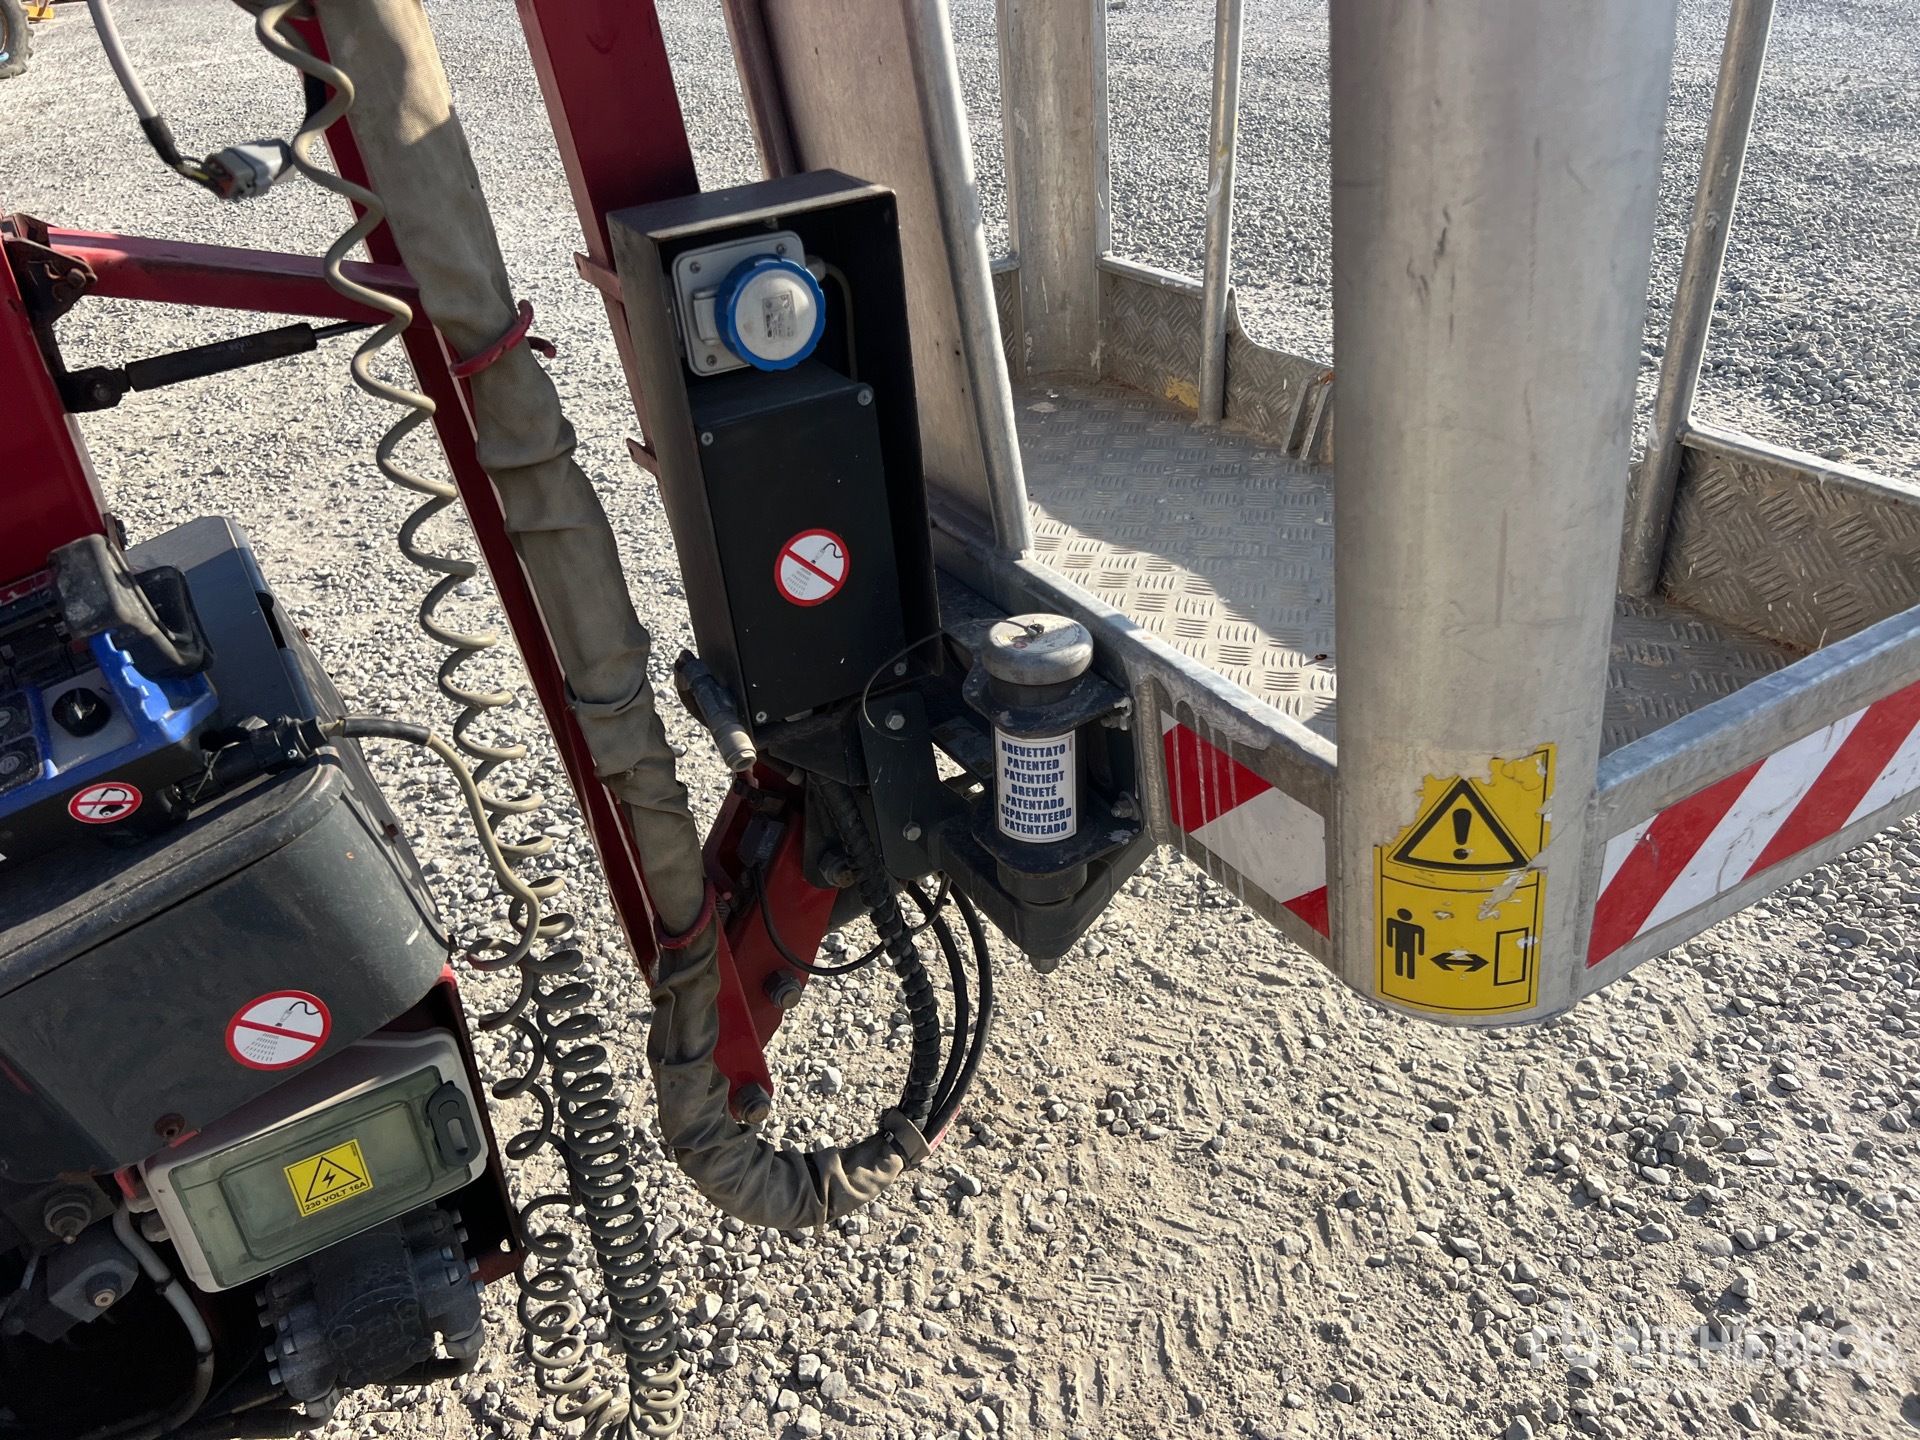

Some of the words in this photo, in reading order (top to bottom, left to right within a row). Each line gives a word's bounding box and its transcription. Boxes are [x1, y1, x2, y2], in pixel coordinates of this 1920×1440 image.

[1001, 741, 1066, 758] BREVETTATO
[1007, 756, 1060, 771] PATENTED
[1004, 768, 1065, 784] PATENTIERT
[1011, 784, 1057, 797] BREVETÉ
[1005, 794, 1064, 810] PATENTADO
[1004, 818, 1067, 835] PATENTEADO
[305, 1201, 321, 1210] 230
[323, 1189, 347, 1202] VOLT
[349, 1181, 367, 1191] 16A
